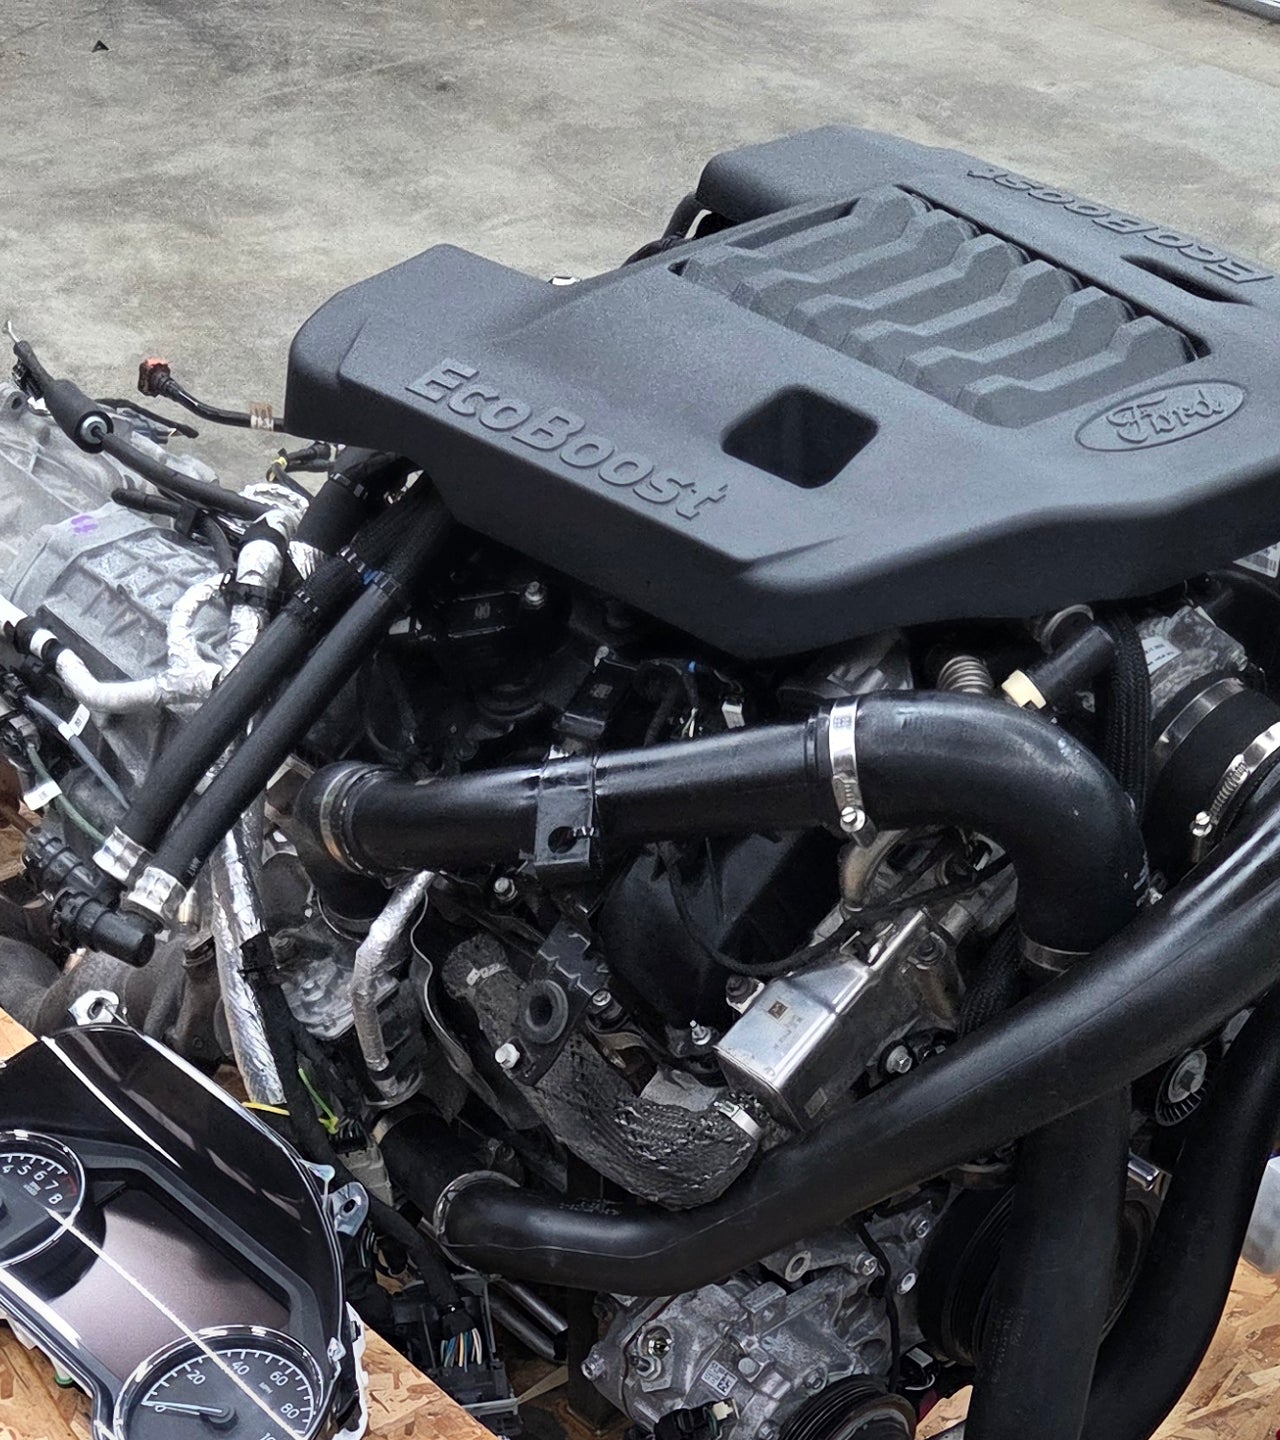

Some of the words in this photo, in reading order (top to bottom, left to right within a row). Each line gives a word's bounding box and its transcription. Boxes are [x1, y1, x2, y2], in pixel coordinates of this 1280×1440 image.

[966, 167, 1275, 285] EcoBoost
[1106, 389, 1224, 445] Ford
[405, 358, 728, 521] EcoBoost
[2, 1164, 14, 1174] 4
[17, 1165, 32, 1176] 5
[33, 1170, 48, 1181] 6
[45, 1180, 59, 1191] 7
[48, 1193, 63, 1205] 8
[186, 1369, 206, 1385] 20
[232, 1361, 250, 1376] 40
[270, 1371, 289, 1386] 60
[280, 1402, 300, 1419] 80
